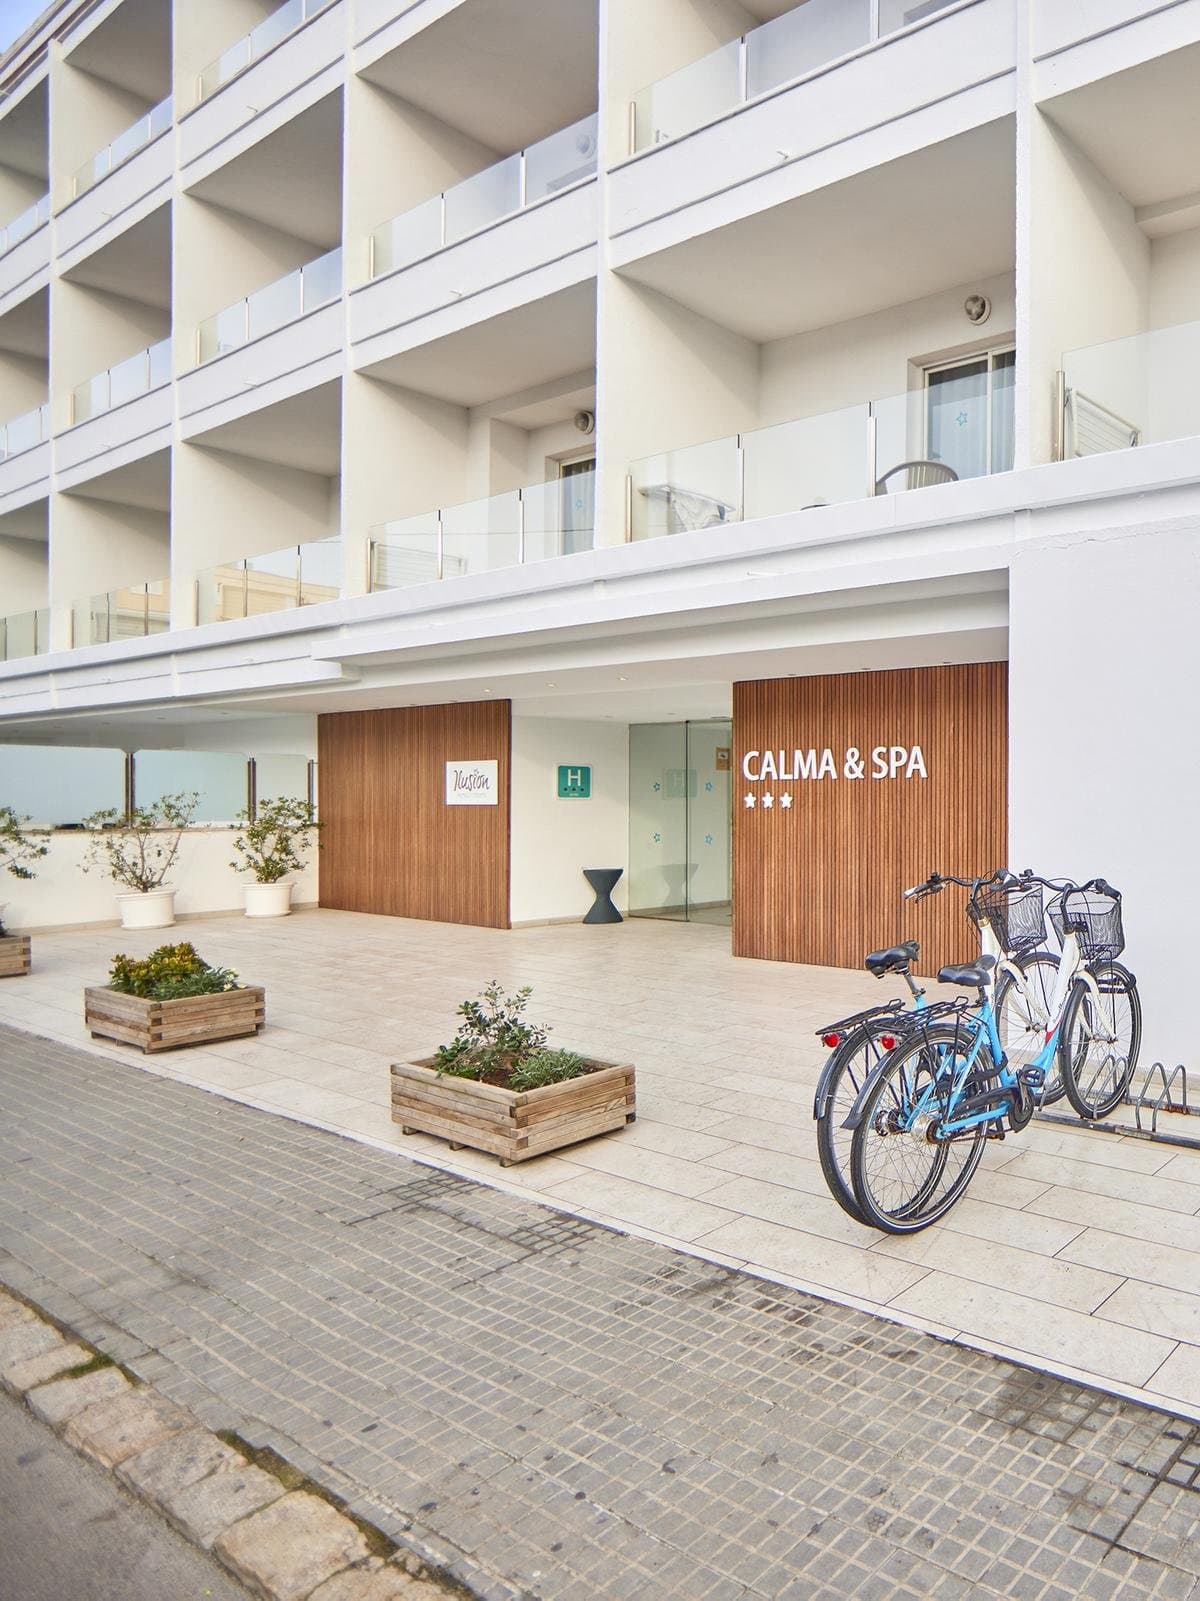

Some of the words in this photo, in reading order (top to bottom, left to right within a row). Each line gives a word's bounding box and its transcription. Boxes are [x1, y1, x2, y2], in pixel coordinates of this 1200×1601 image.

[743, 748, 838, 781] CALMA
[843, 747, 865, 780] &
[871, 745, 928, 779] SPA
[567, 769, 581, 787] H
